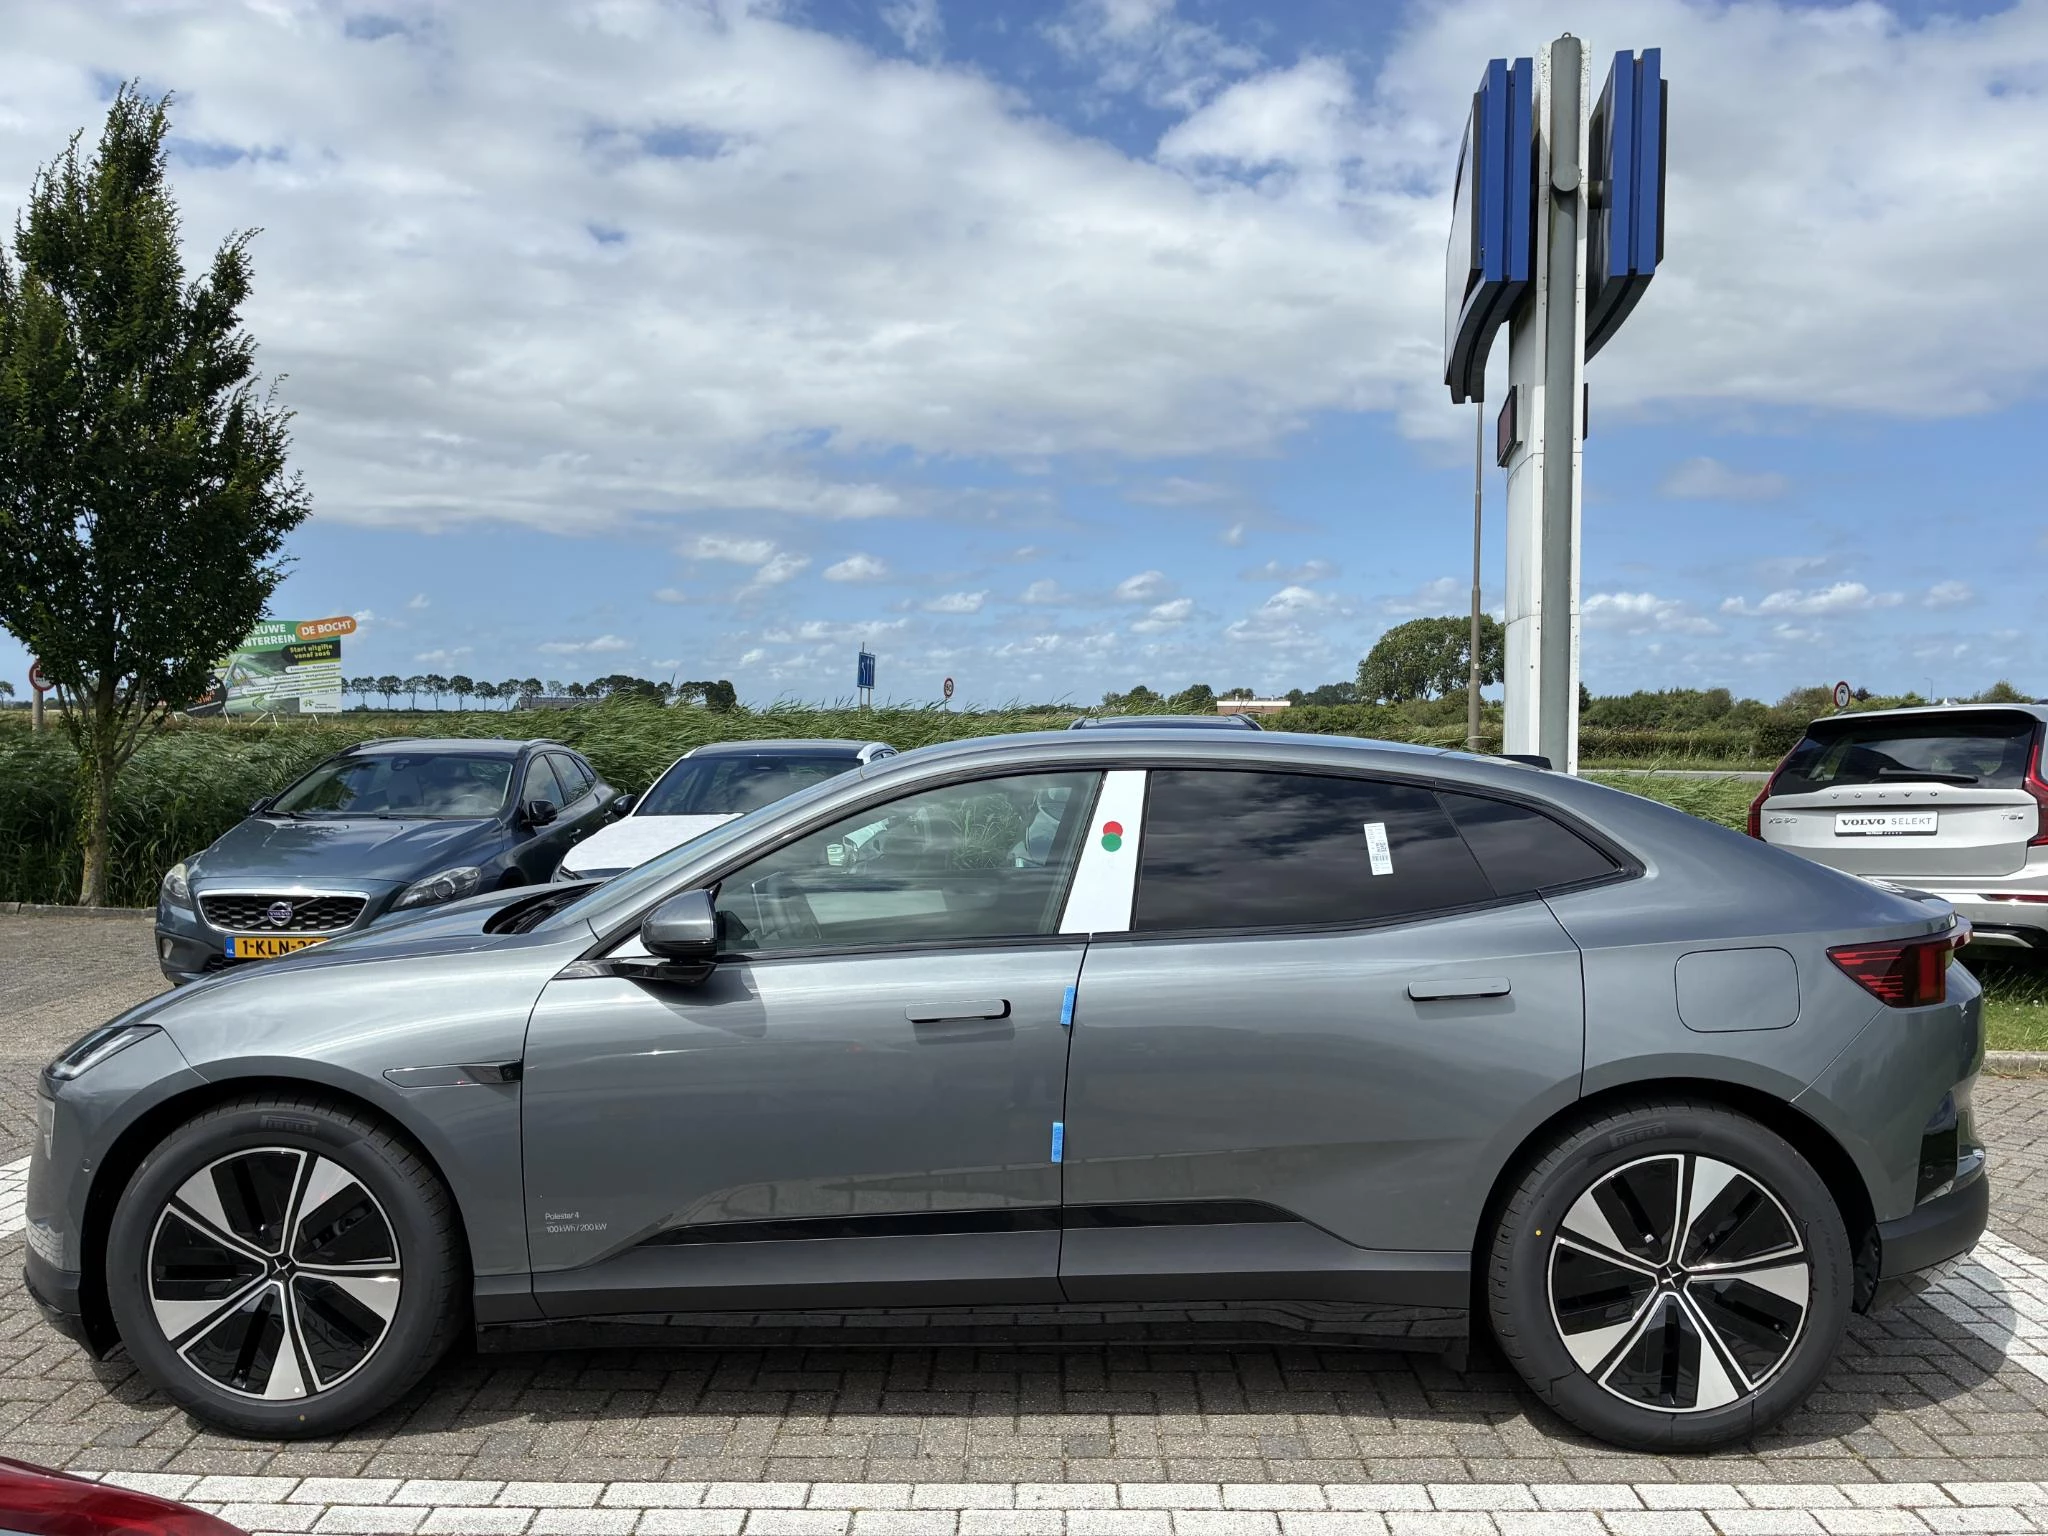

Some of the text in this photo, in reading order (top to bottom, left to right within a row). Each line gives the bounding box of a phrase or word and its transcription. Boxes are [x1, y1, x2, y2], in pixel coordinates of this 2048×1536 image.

[252, 623, 286, 635] EUWE
[301, 620, 352, 636] DE BOCHT
[242, 633, 296, 648] NTERREIN
[290, 645, 306, 653] Start
[294, 651, 313, 659] vanaf
[1831, 791, 1938, 799] VOLVO
[1841, 817, 1933, 826] VOLVO SELEKT
